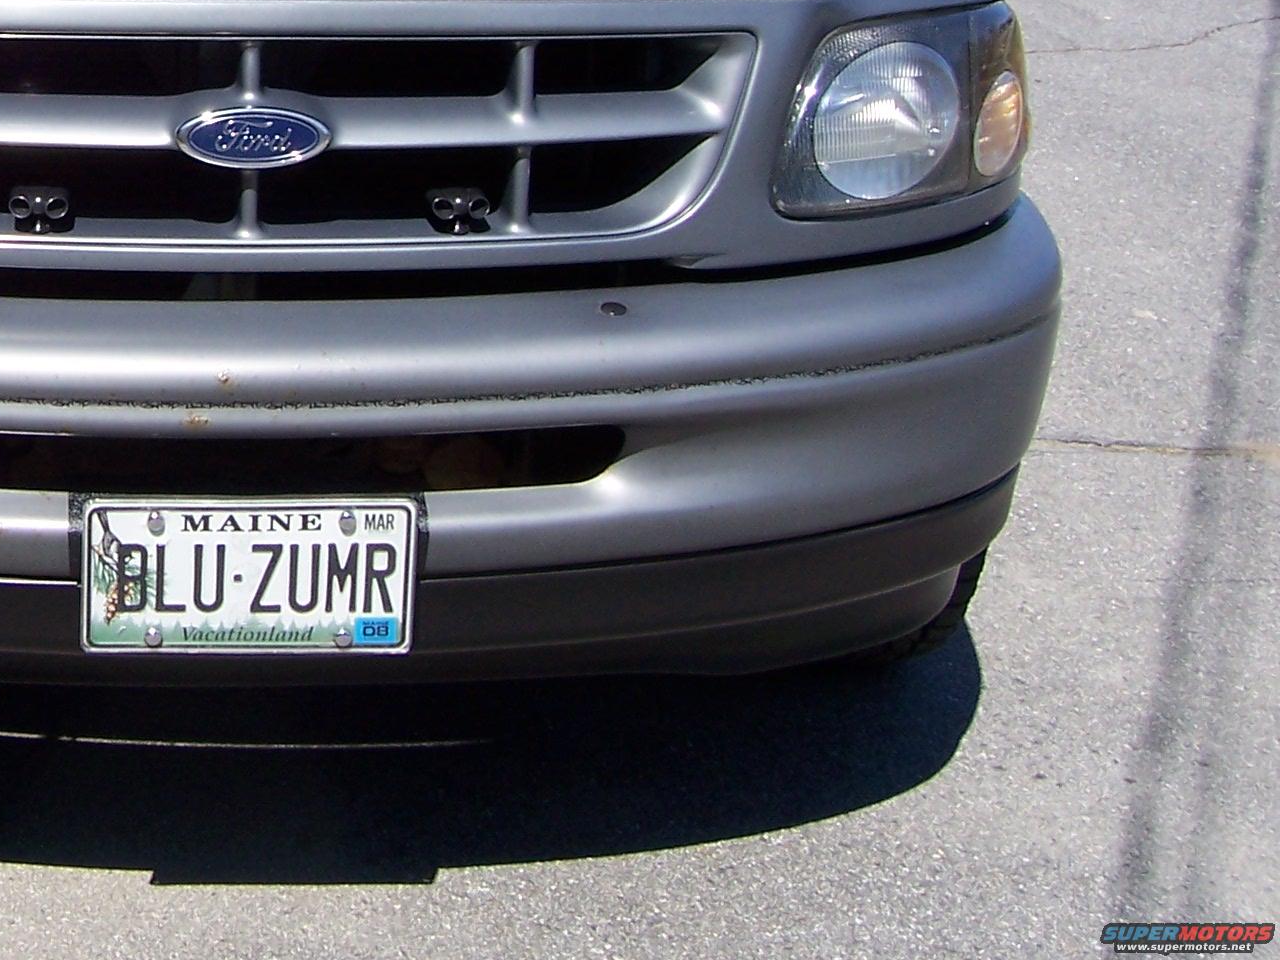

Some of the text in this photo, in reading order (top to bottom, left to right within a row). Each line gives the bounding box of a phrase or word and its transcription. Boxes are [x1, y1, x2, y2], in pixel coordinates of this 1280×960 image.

[215, 119, 293, 152] Ford
[180, 513, 322, 533] MAINE
[363, 513, 396, 531] MAR
[182, 626, 314, 643] Vacationland
[362, 625, 389, 637] 08
